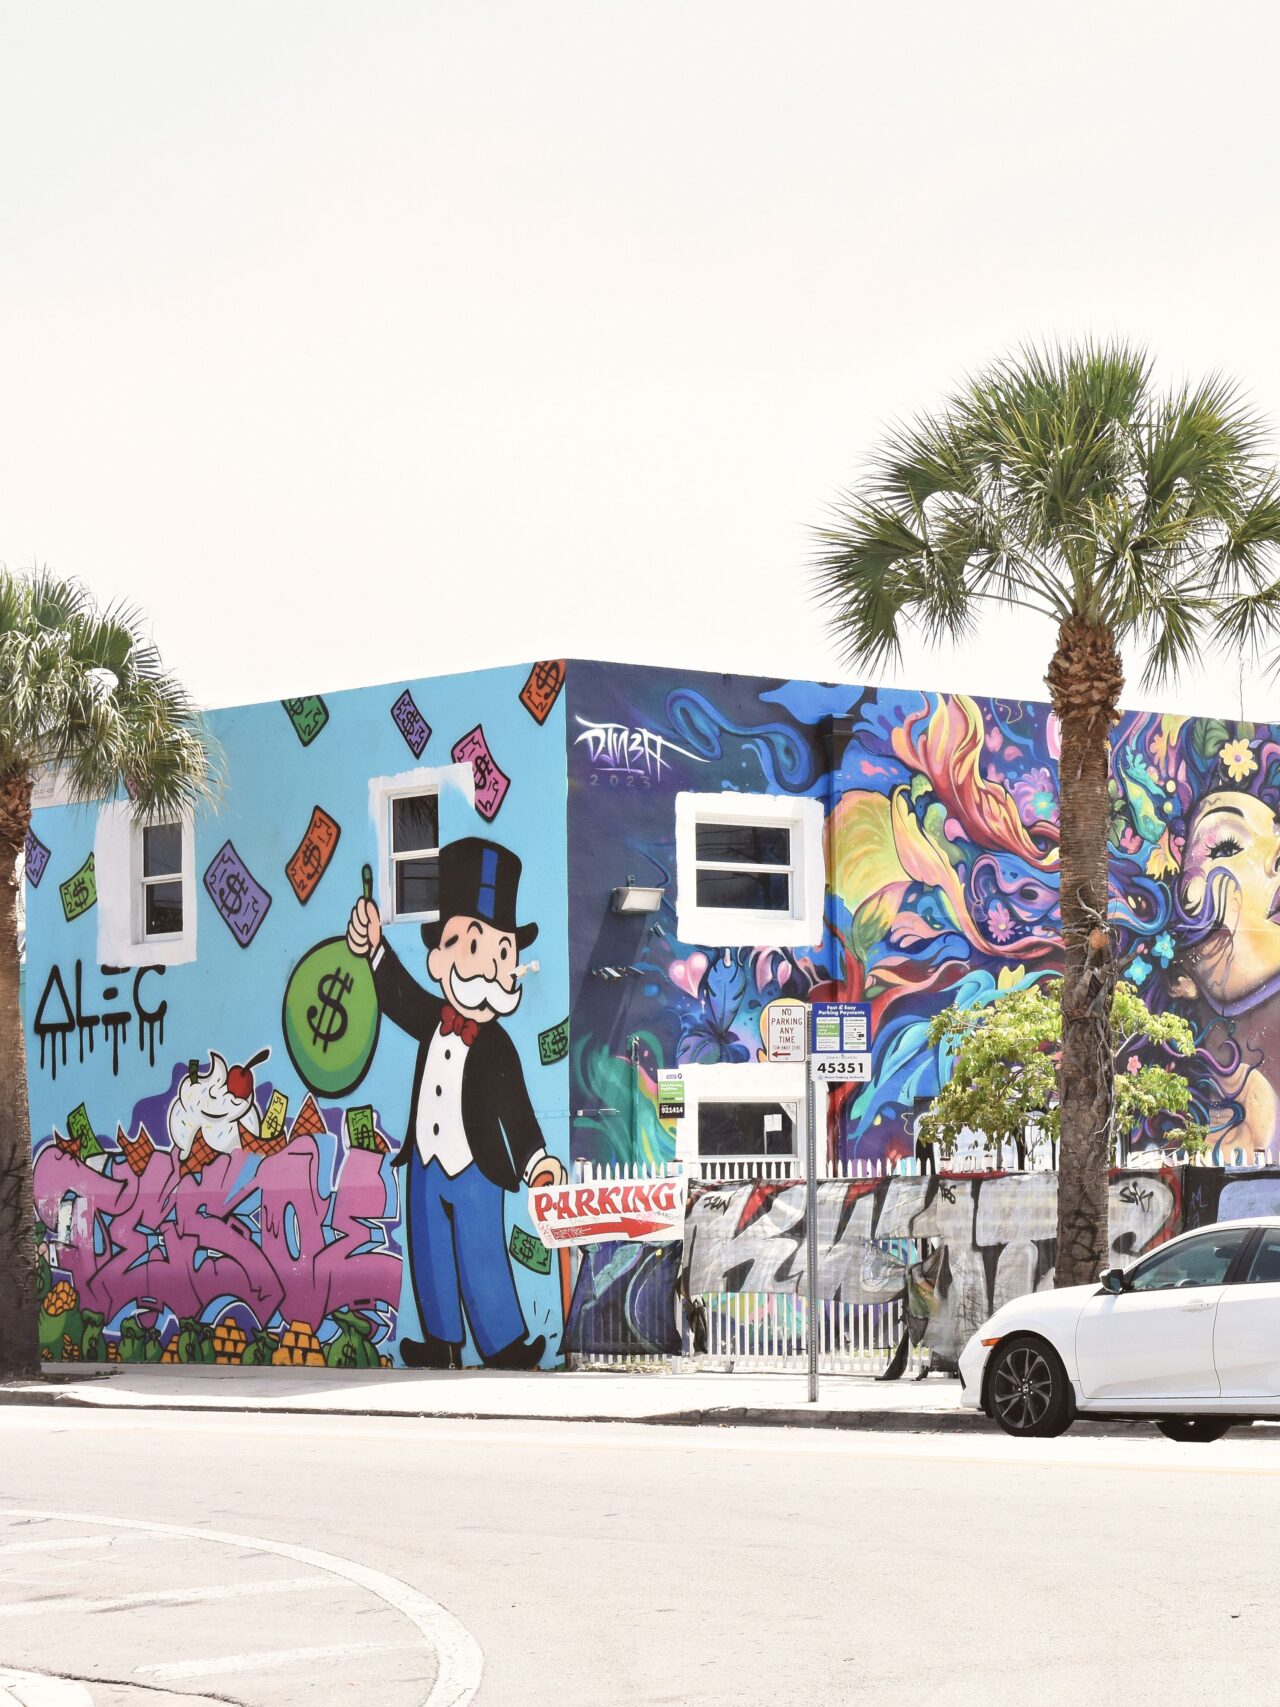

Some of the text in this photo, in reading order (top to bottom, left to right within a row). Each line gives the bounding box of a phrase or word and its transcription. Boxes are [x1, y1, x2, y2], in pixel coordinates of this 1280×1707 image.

[590, 774, 651, 788] 2023
[781, 1008, 792, 1016] NO
[771, 1018, 803, 1026] PARKING
[779, 1036, 796, 1044] TIME
[816, 1062, 865, 1074] 45351
[534, 1182, 677, 1222] PARKING
